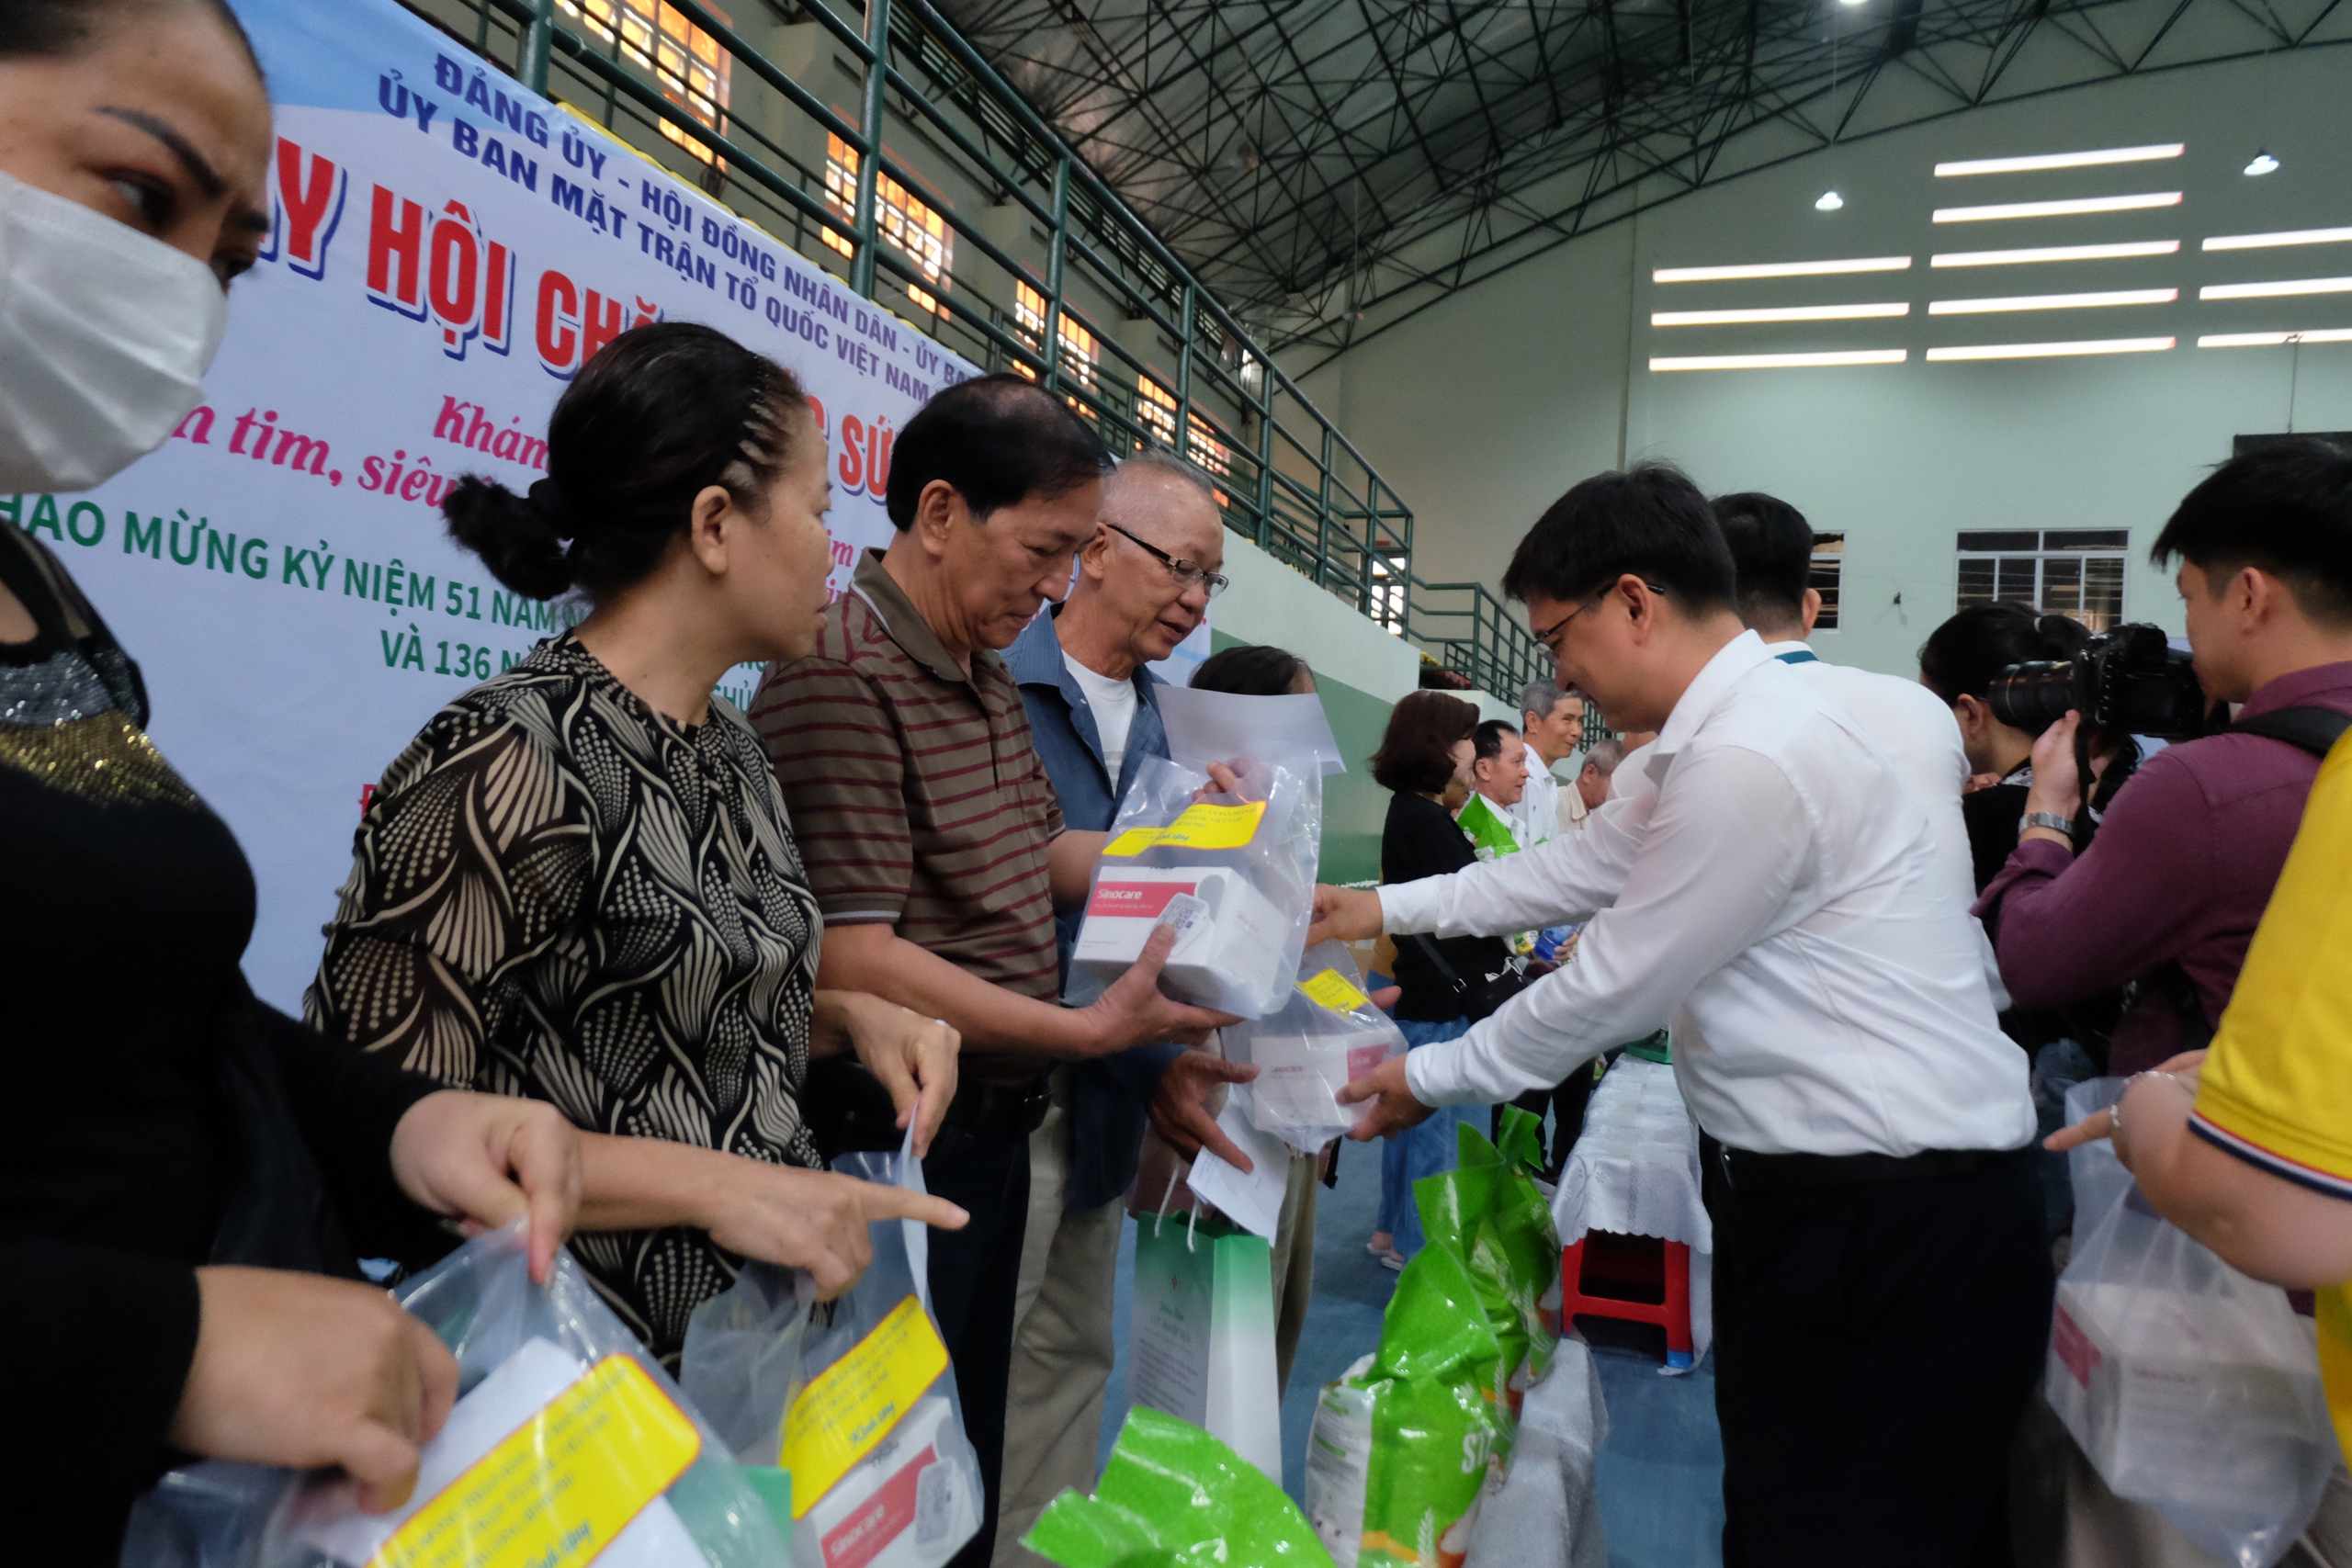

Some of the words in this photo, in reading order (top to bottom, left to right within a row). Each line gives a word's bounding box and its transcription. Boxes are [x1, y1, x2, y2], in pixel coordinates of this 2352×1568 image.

[379, 68, 438, 134] ỦY
[453, 117, 537, 193] BAN
[551, 173, 628, 240] MẶT
[638, 220, 716, 291] TRẬN
[725, 270, 760, 311] TỔ
[766, 295, 829, 350] QUỐC
[836, 333, 880, 377] VIỆT
[885, 362, 930, 404] NAM
[434, 52, 548, 150] ĐẢNG
[562, 125, 607, 181] ỦY
[641, 178, 692, 234] HỘI
[702, 215, 775, 283] ĐỒNG
[784, 265, 848, 325] NHÂN
[854, 309, 897, 354] DÂN
[915, 339, 939, 376] ỦY
[943, 362, 974, 386] BA
[367, 183, 513, 358] HỘI
[839, 414, 895, 503] SỨ
[228, 407, 342, 487] tim,
[123, 508, 268, 580] MỪNG
[282, 538, 335, 591] KỶ
[344, 558, 435, 617] NIỆM
[445, 581, 481, 621] 51
[380, 622, 424, 671] VÀ
[435, 640, 491, 681] 136
[1097, 888, 1143, 899] Sinocare
